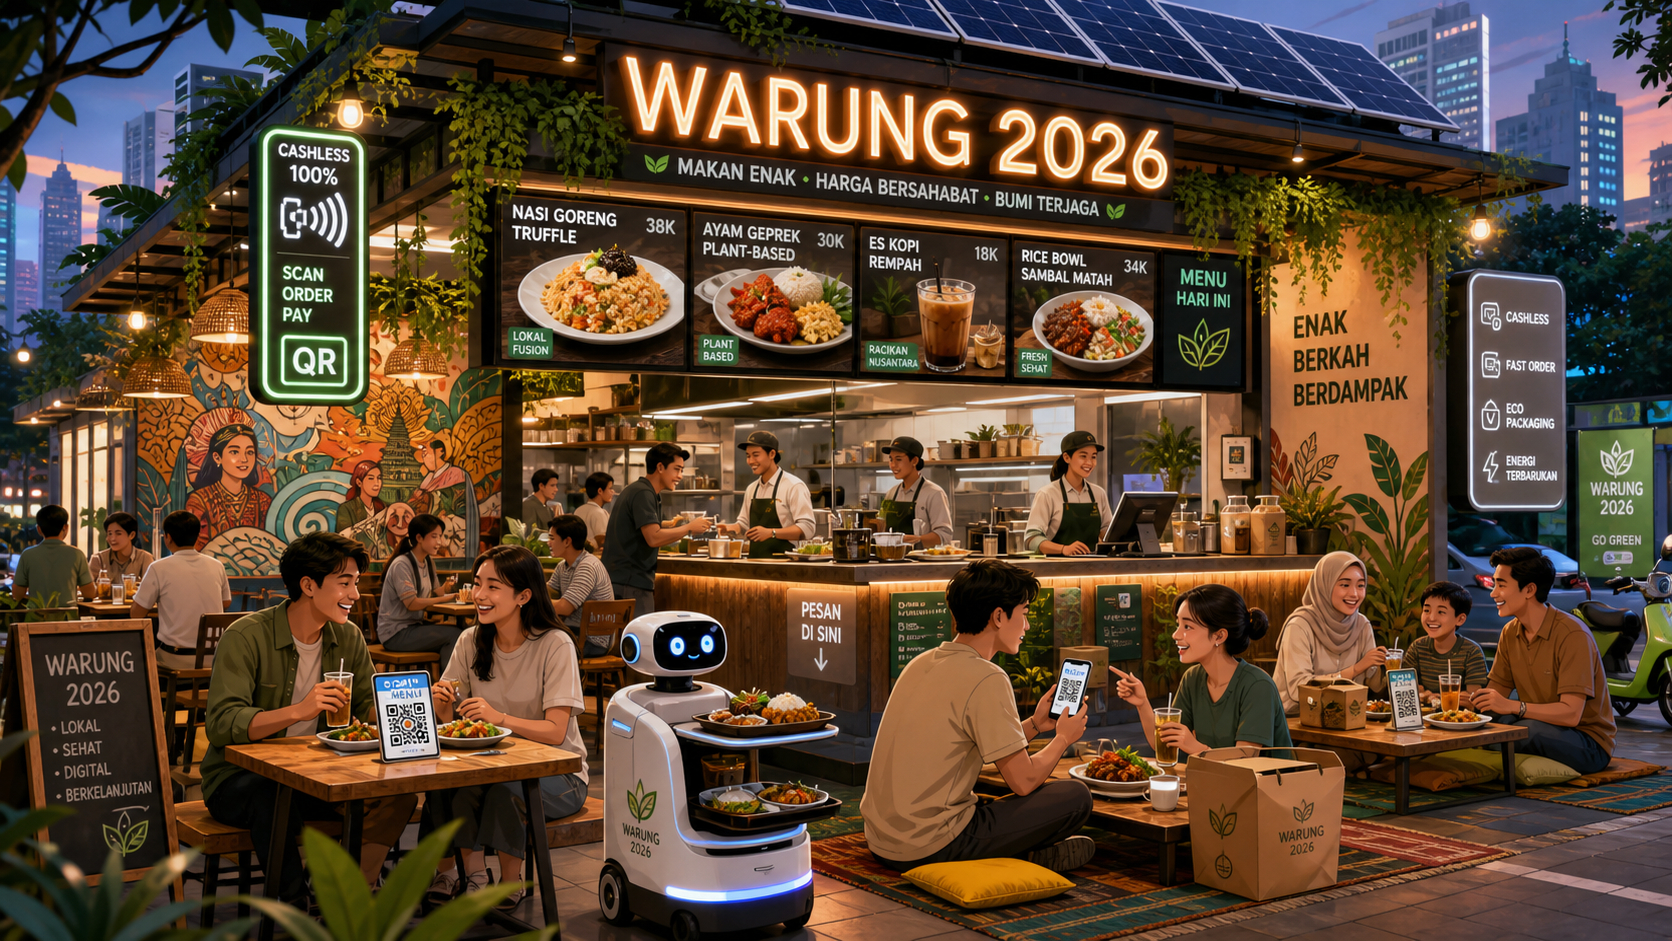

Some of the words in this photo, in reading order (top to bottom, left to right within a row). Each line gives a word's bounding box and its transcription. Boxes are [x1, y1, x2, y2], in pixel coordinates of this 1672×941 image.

[624, 55, 971, 167] WARUNG
[997, 108, 1169, 190] 2026
[278, 142, 351, 163] CASHLESS
[289, 164, 338, 185] 100%
[677, 157, 745, 182] MAKAN
[749, 164, 797, 187] ENAK
[815, 172, 873, 194] HARGA
[877, 177, 979, 204] BERSAHABAT
[994, 191, 1033, 211] BUMI
[1036, 195, 1100, 217] TERJAGA
[512, 204, 549, 222] NASI
[553, 207, 617, 227] GORENG
[512, 225, 577, 244] TRUFFLE
[646, 217, 676, 235] 38K
[703, 221, 744, 239] AYAM
[747, 225, 801, 244] GEPREK
[817, 232, 845, 249] 30K
[869, 236, 886, 250] ES
[888, 238, 920, 253] KOPI
[702, 241, 796, 262] PLANT-BASED
[974, 246, 998, 262] 18K
[1021, 249, 1048, 264] RICE
[1052, 251, 1087, 267] BOWL
[869, 255, 922, 272] REMPAH
[1124, 259, 1148, 274] 34K
[282, 265, 324, 282] SCAN
[1021, 267, 1070, 284] SAMBAL
[1073, 272, 1113, 287] MATAH
[1180, 268, 1227, 289] MENU
[282, 286, 333, 303] ORDER
[1176, 290, 1209, 307] HARI
[1213, 293, 1231, 309] INI
[282, 307, 312, 323] PAY
[1505, 311, 1549, 326] CASHLESS
[1293, 309, 1348, 339] ENAK
[513, 331, 547, 343] LOKAL
[703, 338, 734, 350] PLANT
[513, 343, 549, 356] FUSION
[703, 351, 735, 362] BASED
[869, 344, 908, 356] RACIKAN
[1021, 351, 1048, 362] FRESH
[1293, 342, 1370, 373] BERKAH
[292, 346, 337, 377] QR
[869, 356, 918, 368] NUSANTARA
[1021, 363, 1048, 374] SEHAT
[1505, 359, 1528, 373] FAST
[1528, 360, 1556, 374] ORDER
[1293, 375, 1408, 407] BERDAMPAK
[1505, 403, 1524, 415] ECO
[1505, 416, 1555, 430] PACKAGING
[1505, 455, 1536, 467] ENERGI
[1505, 469, 1558, 482] TERBARUKAN
[1590, 481, 1644, 496] WARUNG
[1600, 499, 1634, 515] 2026
[1591, 534, 1607, 546] GO
[1609, 534, 1642, 546] GREEN
[801, 601, 841, 621] PESAN
[801, 624, 814, 640] DI
[817, 626, 842, 644] SINI
[45, 651, 134, 676] WARUNG
[66, 681, 120, 706] 2026
[61, 719, 101, 734] LOKAL
[62, 740, 102, 756] SEHAT
[64, 762, 111, 779] DIGITAL
[66, 781, 152, 802] BERKELANJUTAN
[622, 822, 660, 846] WARUNG
[1278, 825, 1325, 843] WARUNG
[630, 841, 652, 859] 2026
[1289, 841, 1314, 856] 2026
